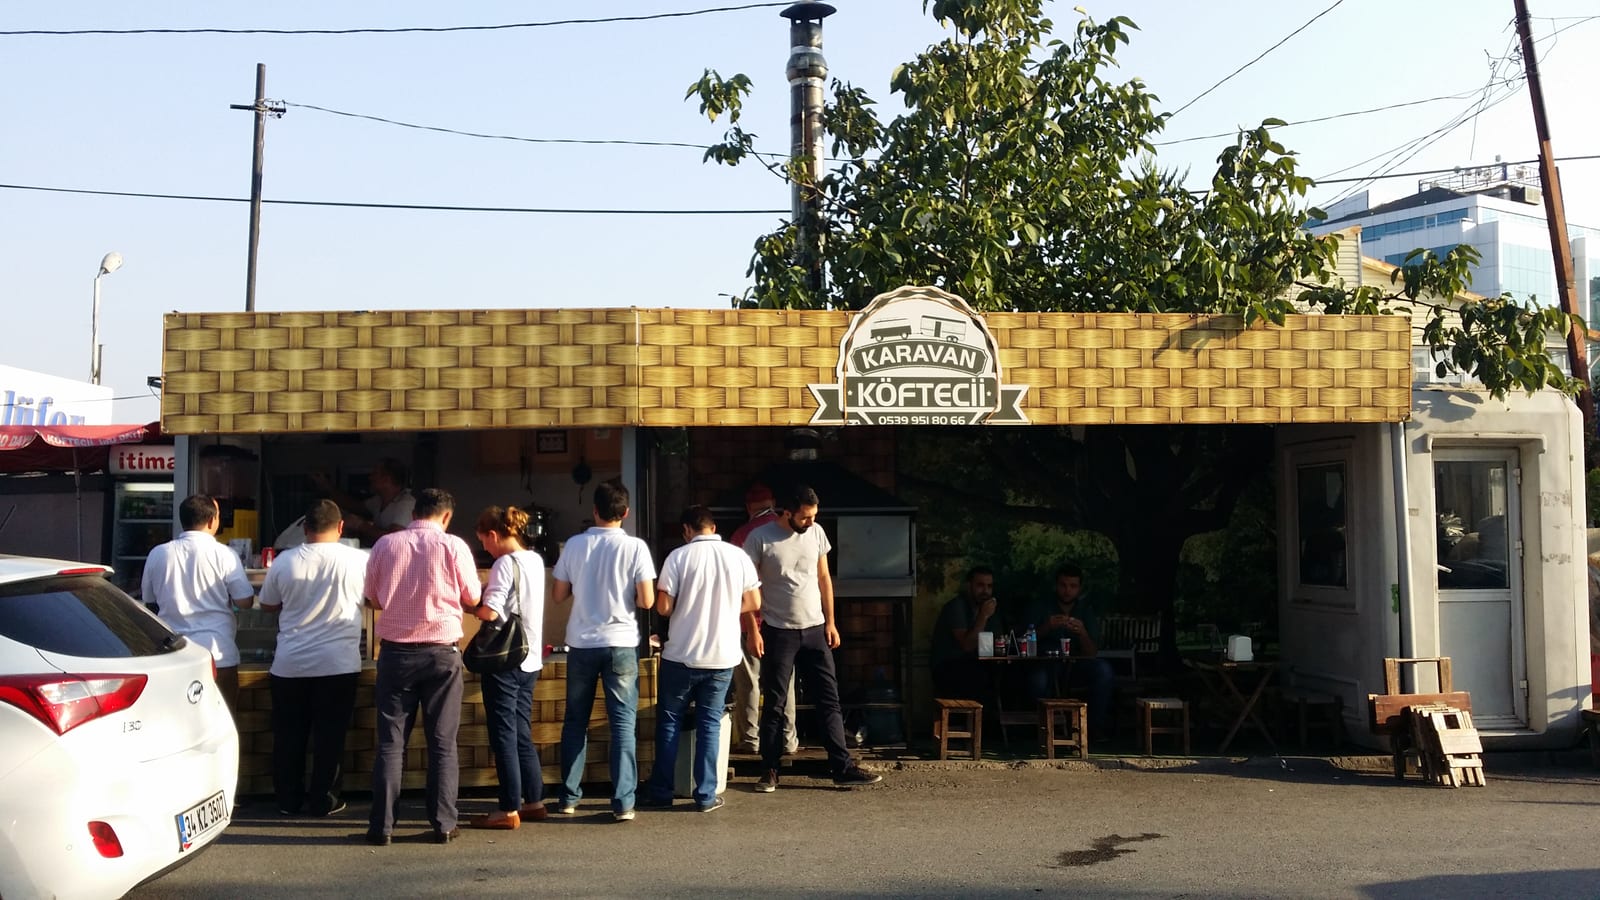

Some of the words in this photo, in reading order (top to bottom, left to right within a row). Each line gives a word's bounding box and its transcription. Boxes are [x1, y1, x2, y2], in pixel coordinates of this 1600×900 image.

[861, 344, 977, 370] KARAVAN
[878, 416, 909, 425] 0539
[911, 416, 929, 425] 951
[932, 416, 948, 425] 80
[950, 416, 966, 425] 66
[185, 813, 197, 838] 34
